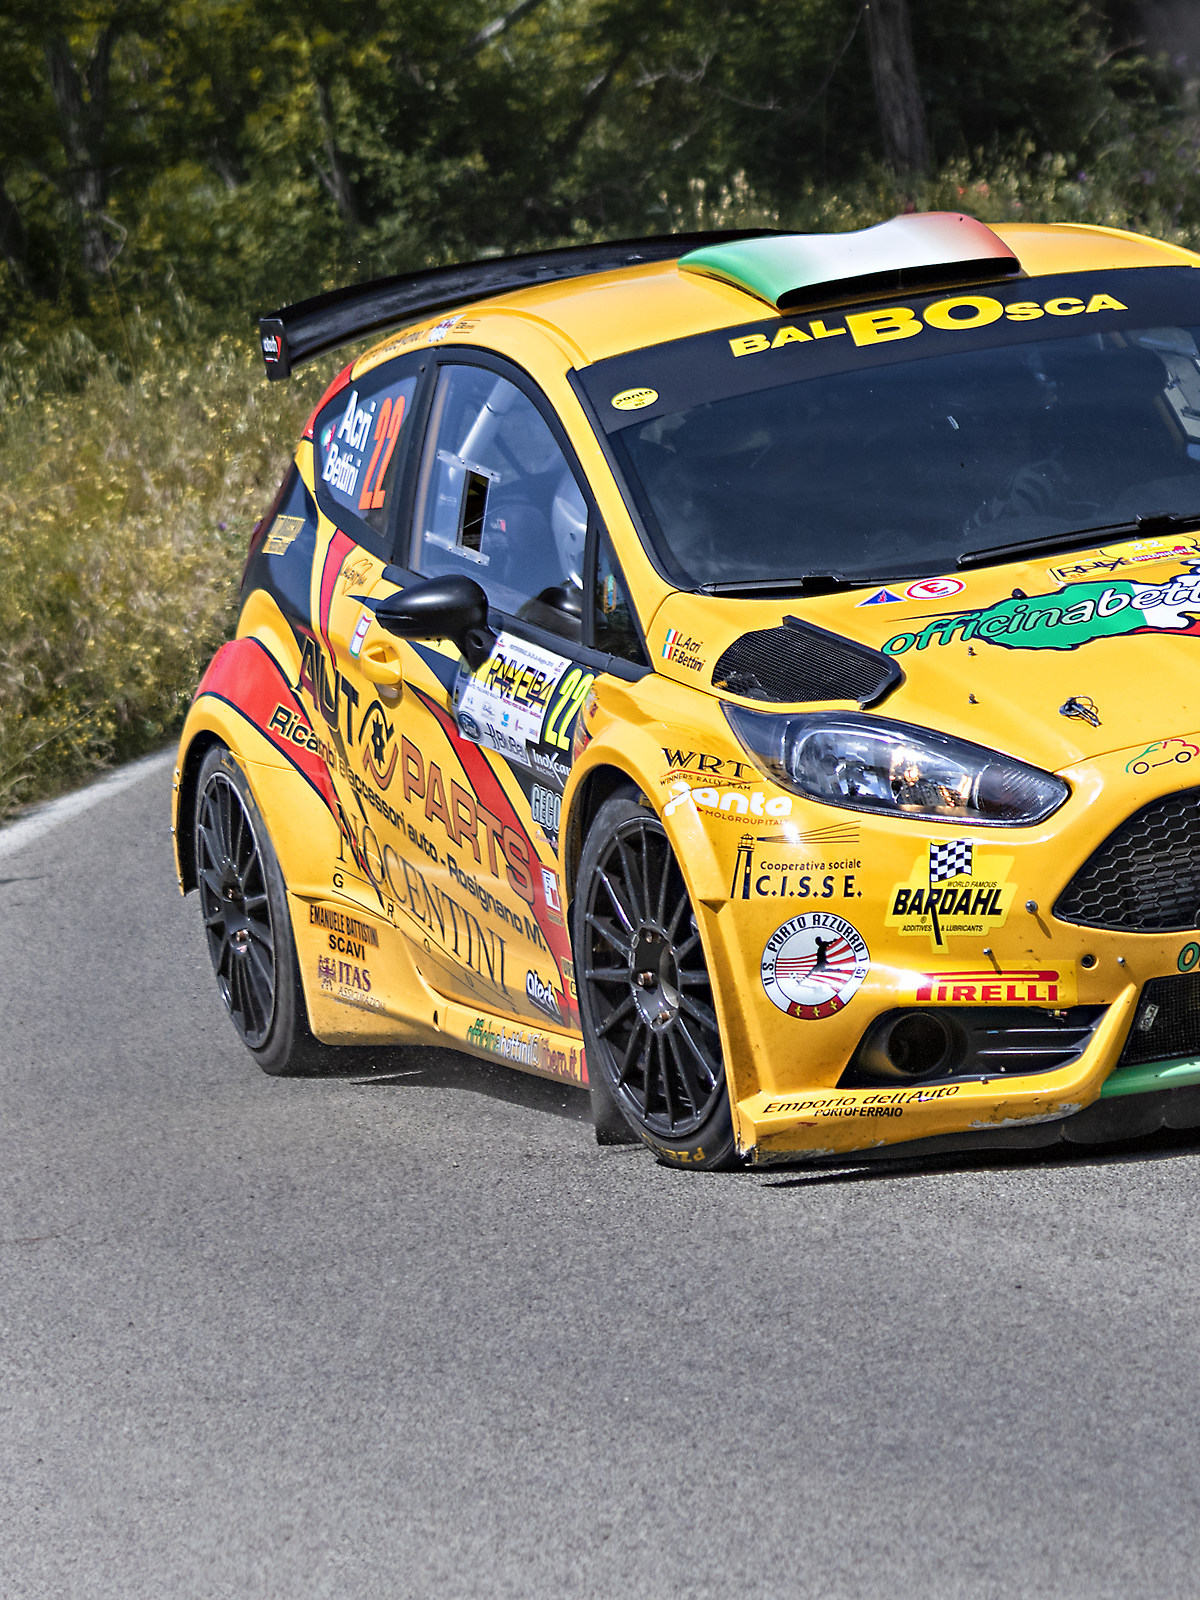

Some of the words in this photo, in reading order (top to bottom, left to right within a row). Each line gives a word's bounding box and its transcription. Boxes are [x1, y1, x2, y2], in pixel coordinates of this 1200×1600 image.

[337, 389, 377, 453] Acri
[358, 395, 406, 510] 22
[322, 443, 362, 496] Bettini
[1128, 539, 1159, 552] 22
[545, 668, 595, 752] 22
[661, 747, 754, 779] WRT
[660, 773, 693, 787] WINNERS
[696, 775, 723, 786] RALLY
[664, 781, 794, 817] panta
[401, 734, 535, 906] PARTS
[760, 861, 826, 873] Cooperativa
[828, 858, 862, 870] sociale
[408, 822, 438, 864] auto
[446, 852, 523, 934] Rosignano
[522, 915, 548, 952] M.
[892, 889, 1003, 916] BARDAHL
[309, 904, 345, 934] EMANUELE
[767, 915, 807, 953] PORTO
[812, 913, 865, 953] AZZURRO
[902, 924, 932, 932] ADDITIVES
[328, 933, 366, 961] SCAVI
[338, 960, 372, 993] ITAS
[762, 958, 776, 987] U.S.
[915, 970, 1060, 1002] PIRELLI
[762, 1095, 857, 1113] Emporio
[862, 1085, 961, 1105] dell'Auto
[813, 1107, 903, 1118] PORTOFERRAIO
